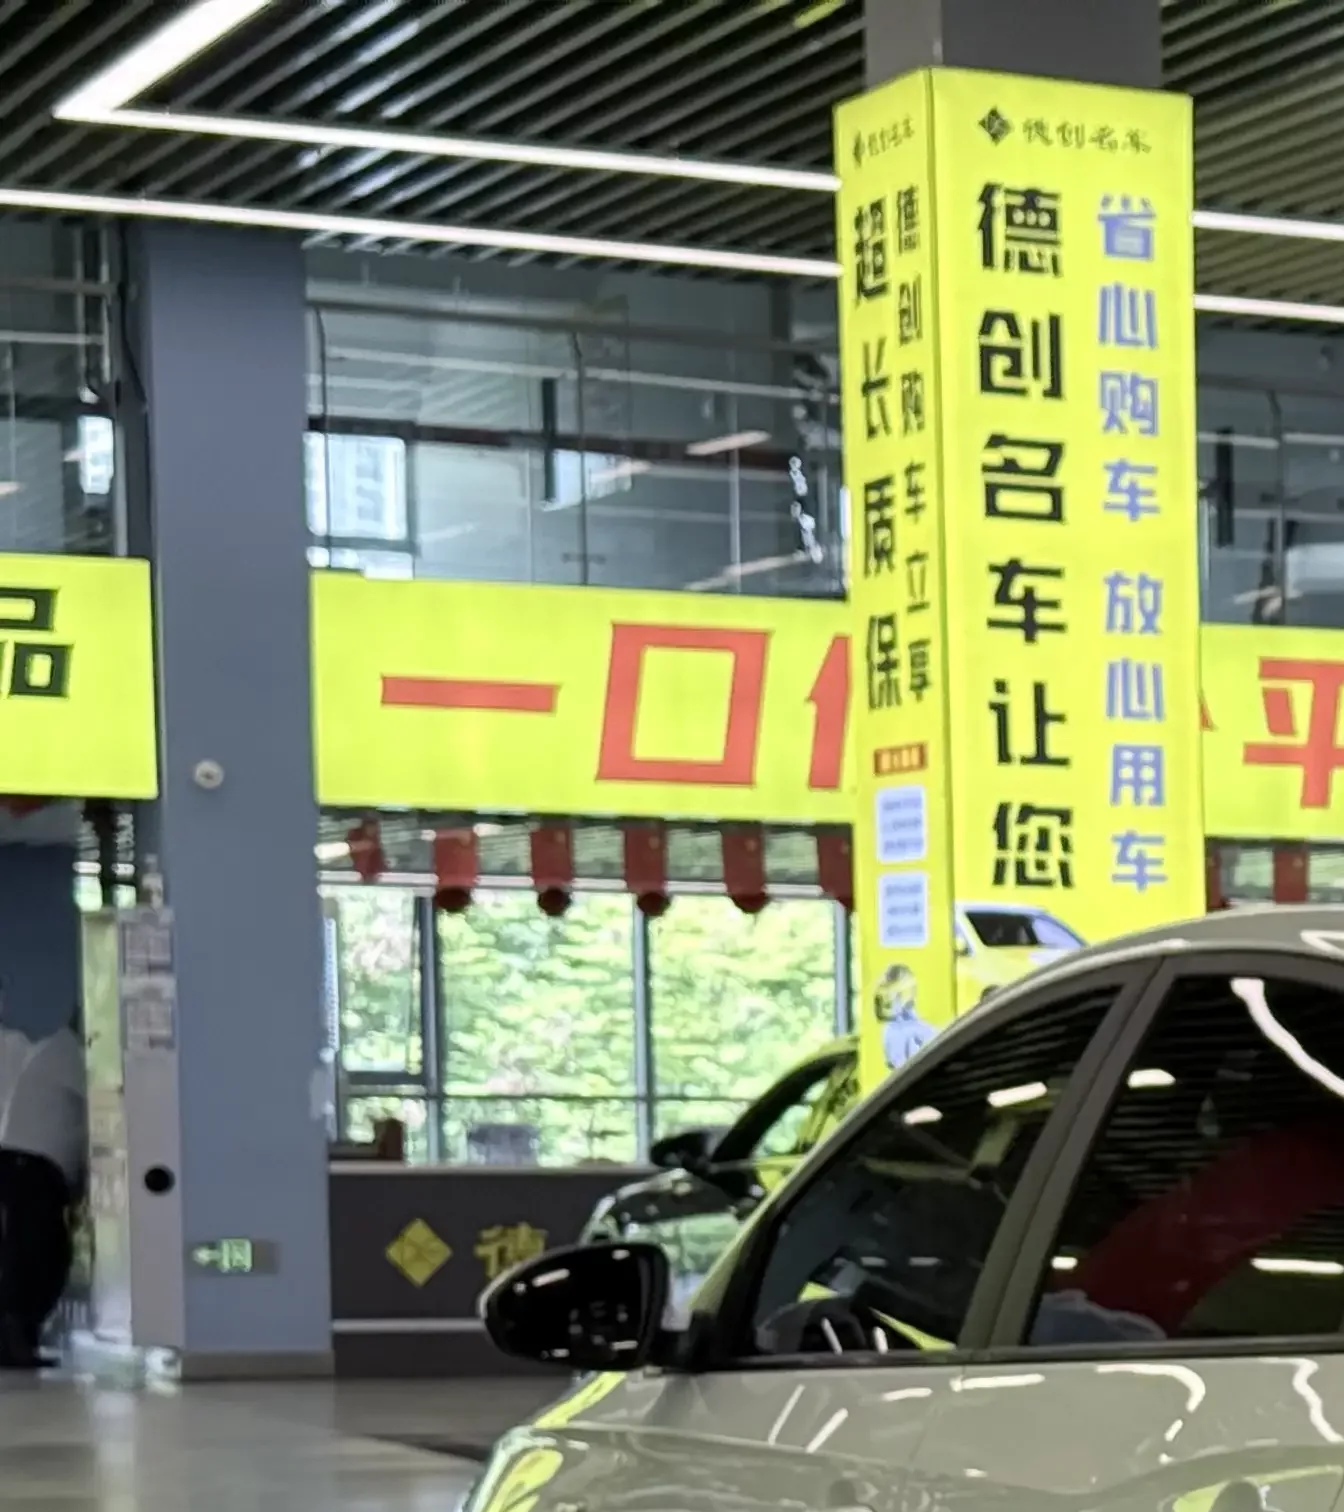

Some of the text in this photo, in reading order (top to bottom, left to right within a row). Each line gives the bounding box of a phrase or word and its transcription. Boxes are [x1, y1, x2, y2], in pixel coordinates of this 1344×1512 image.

[854, 194, 901, 710] 超长质保
[896, 184, 932, 703] 德创购车立享
[977, 182, 1073, 889] 德创名车让您
